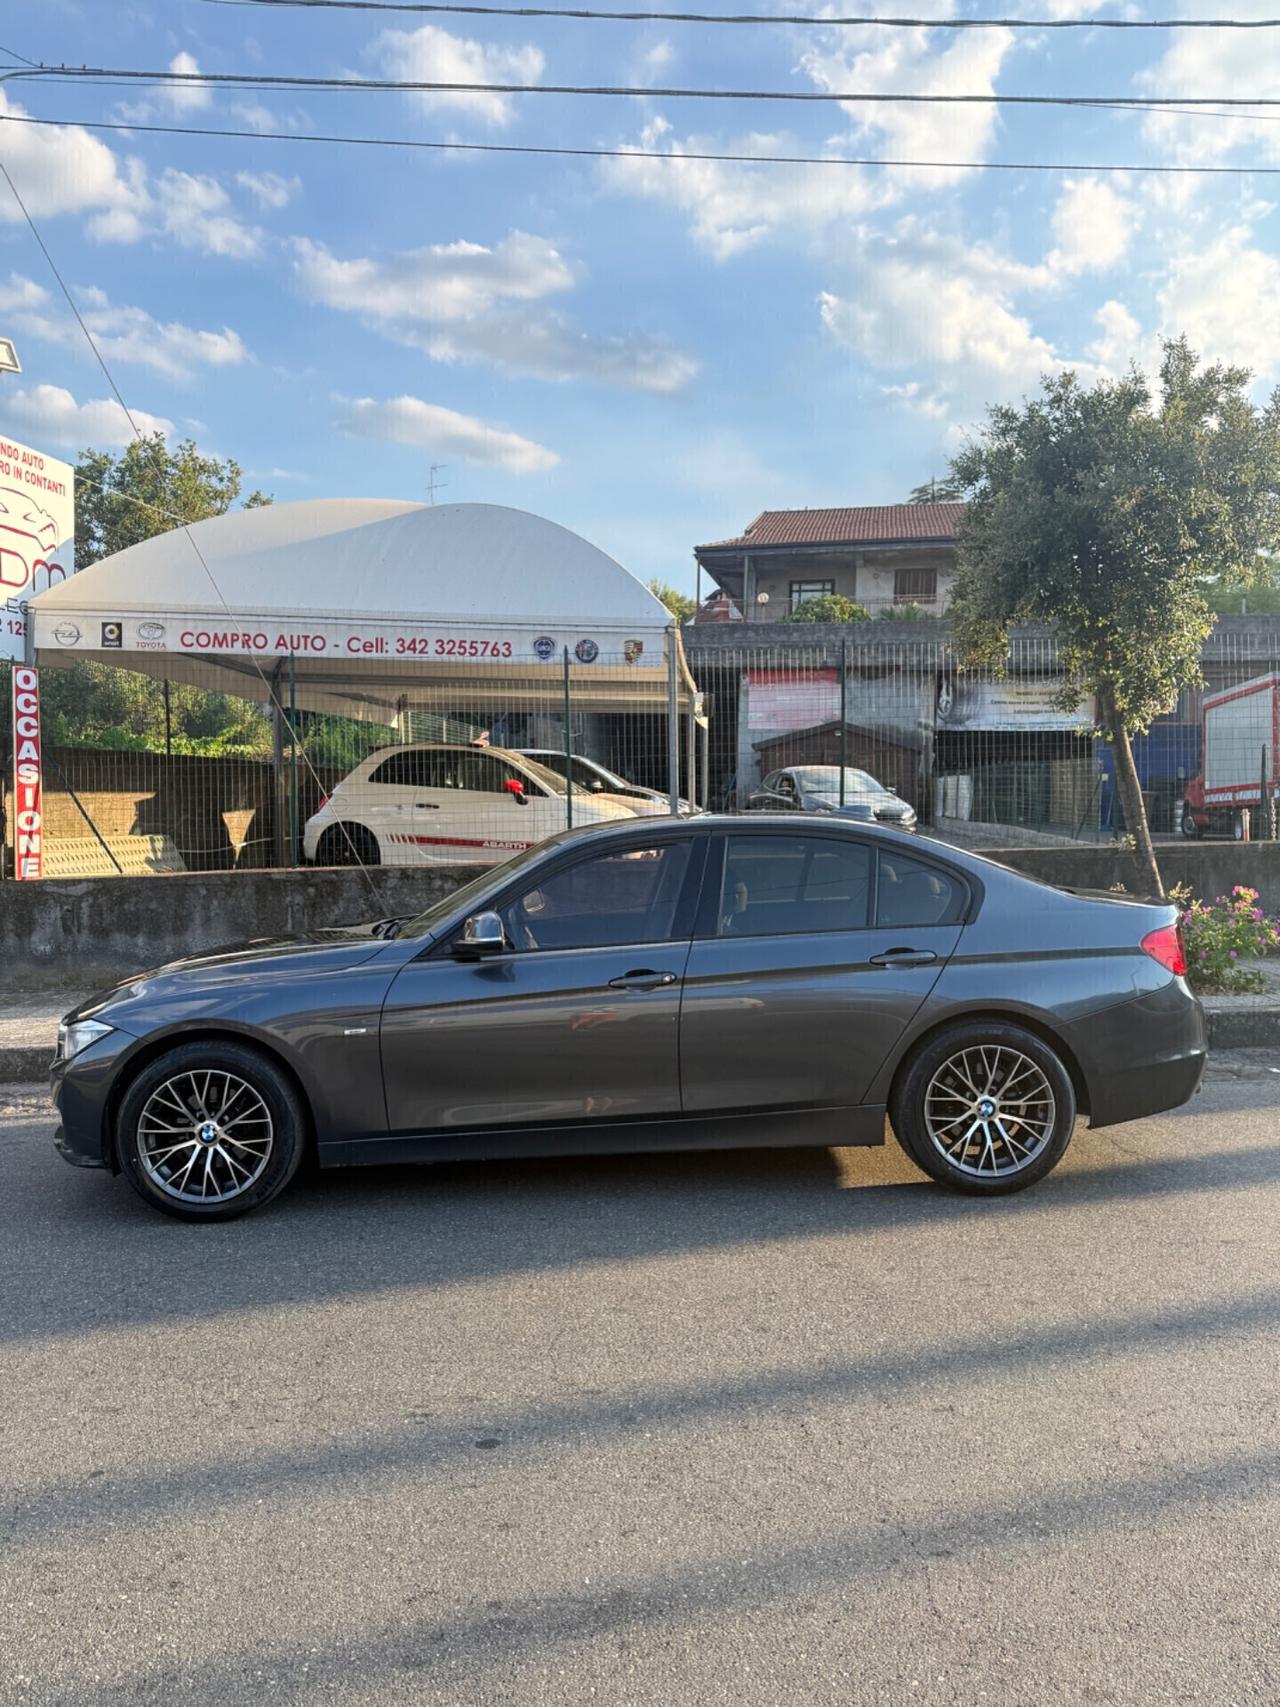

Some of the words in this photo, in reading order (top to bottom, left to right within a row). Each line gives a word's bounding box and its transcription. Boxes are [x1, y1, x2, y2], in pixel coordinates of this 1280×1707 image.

[21, 451, 44, 471] AUTO
[13, 465, 22, 480] IN
[25, 470, 66, 496] CONTANTI
[136, 641, 167, 649] TOYOTA
[180, 631, 268, 649] COMPRO
[274, 634, 326, 651] AUTO
[347, 636, 389, 653] Cell:
[395, 638, 429, 654] 342
[434, 639, 512, 657] 3255763
[15, 669, 41, 877] OCCASIONE
[482, 841, 527, 849] ABARTH
